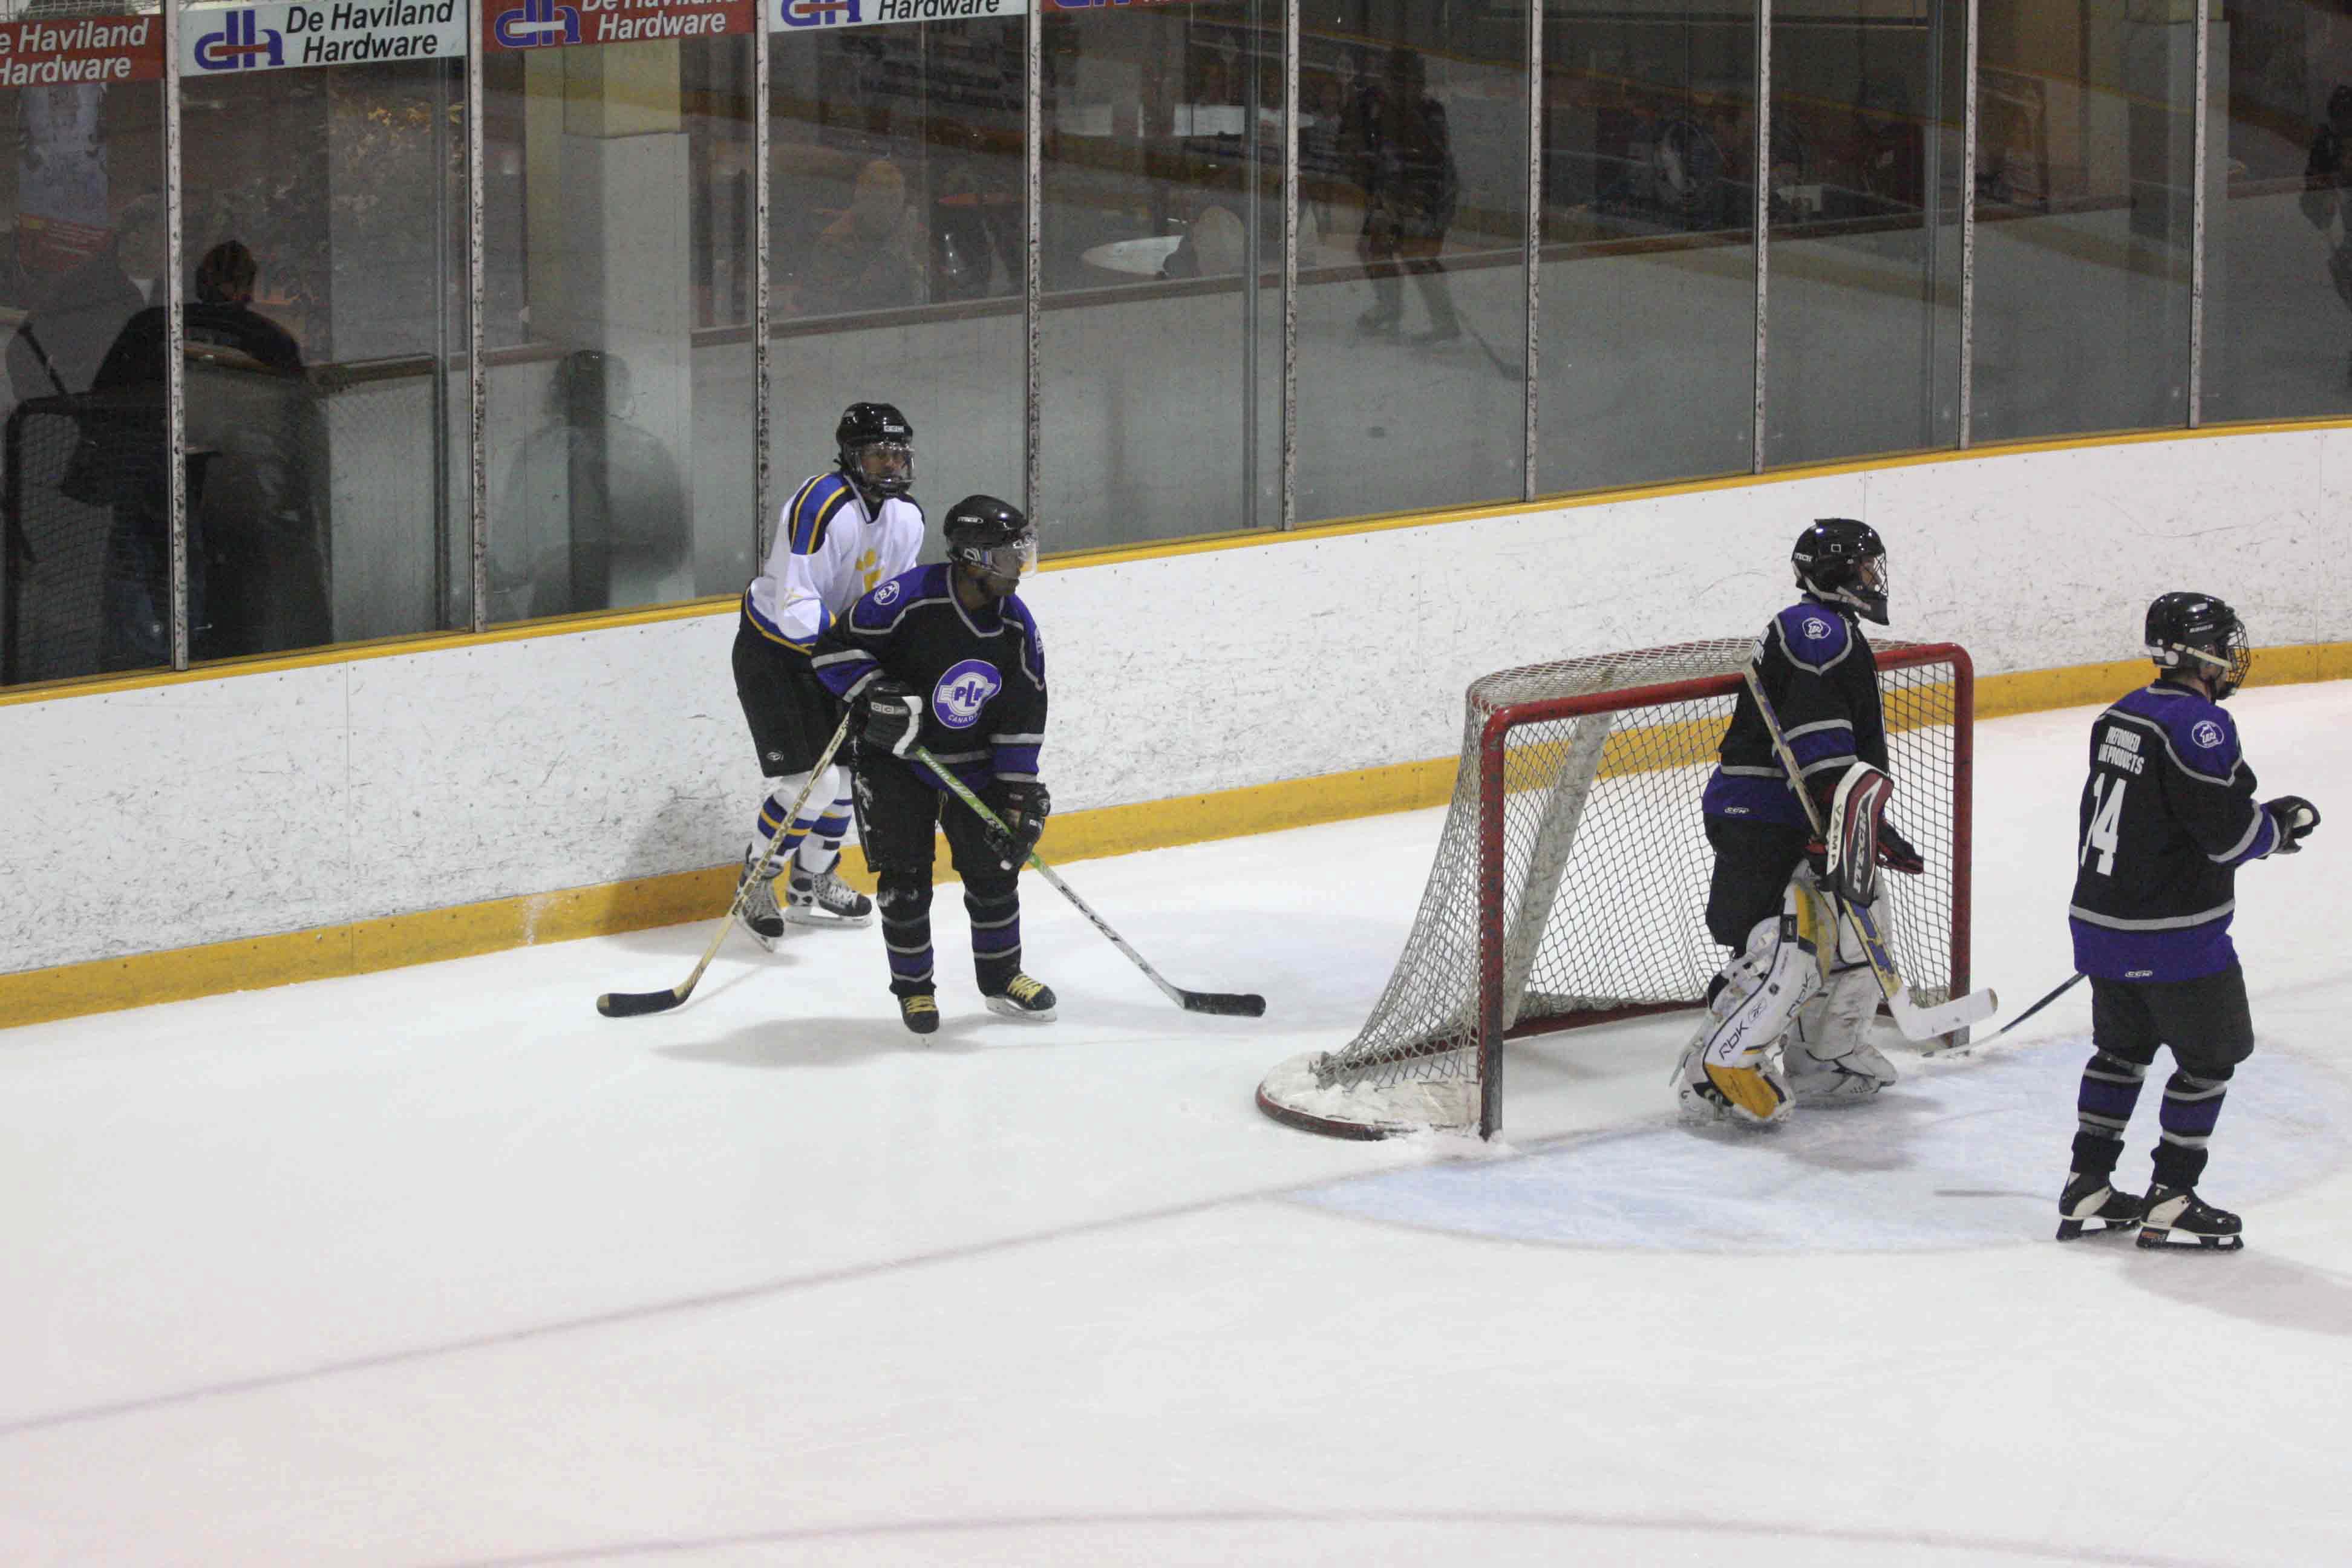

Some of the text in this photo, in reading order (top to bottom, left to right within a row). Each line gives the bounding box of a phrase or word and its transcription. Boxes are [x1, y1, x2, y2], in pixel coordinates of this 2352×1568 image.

[286, 0, 454, 34] De Haviland
[597, 11, 727, 41] Hardware
[0, 18, 149, 54] e Haviland
[302, 32, 439, 64] Hardware
[2080, 772, 2128, 877] 14
